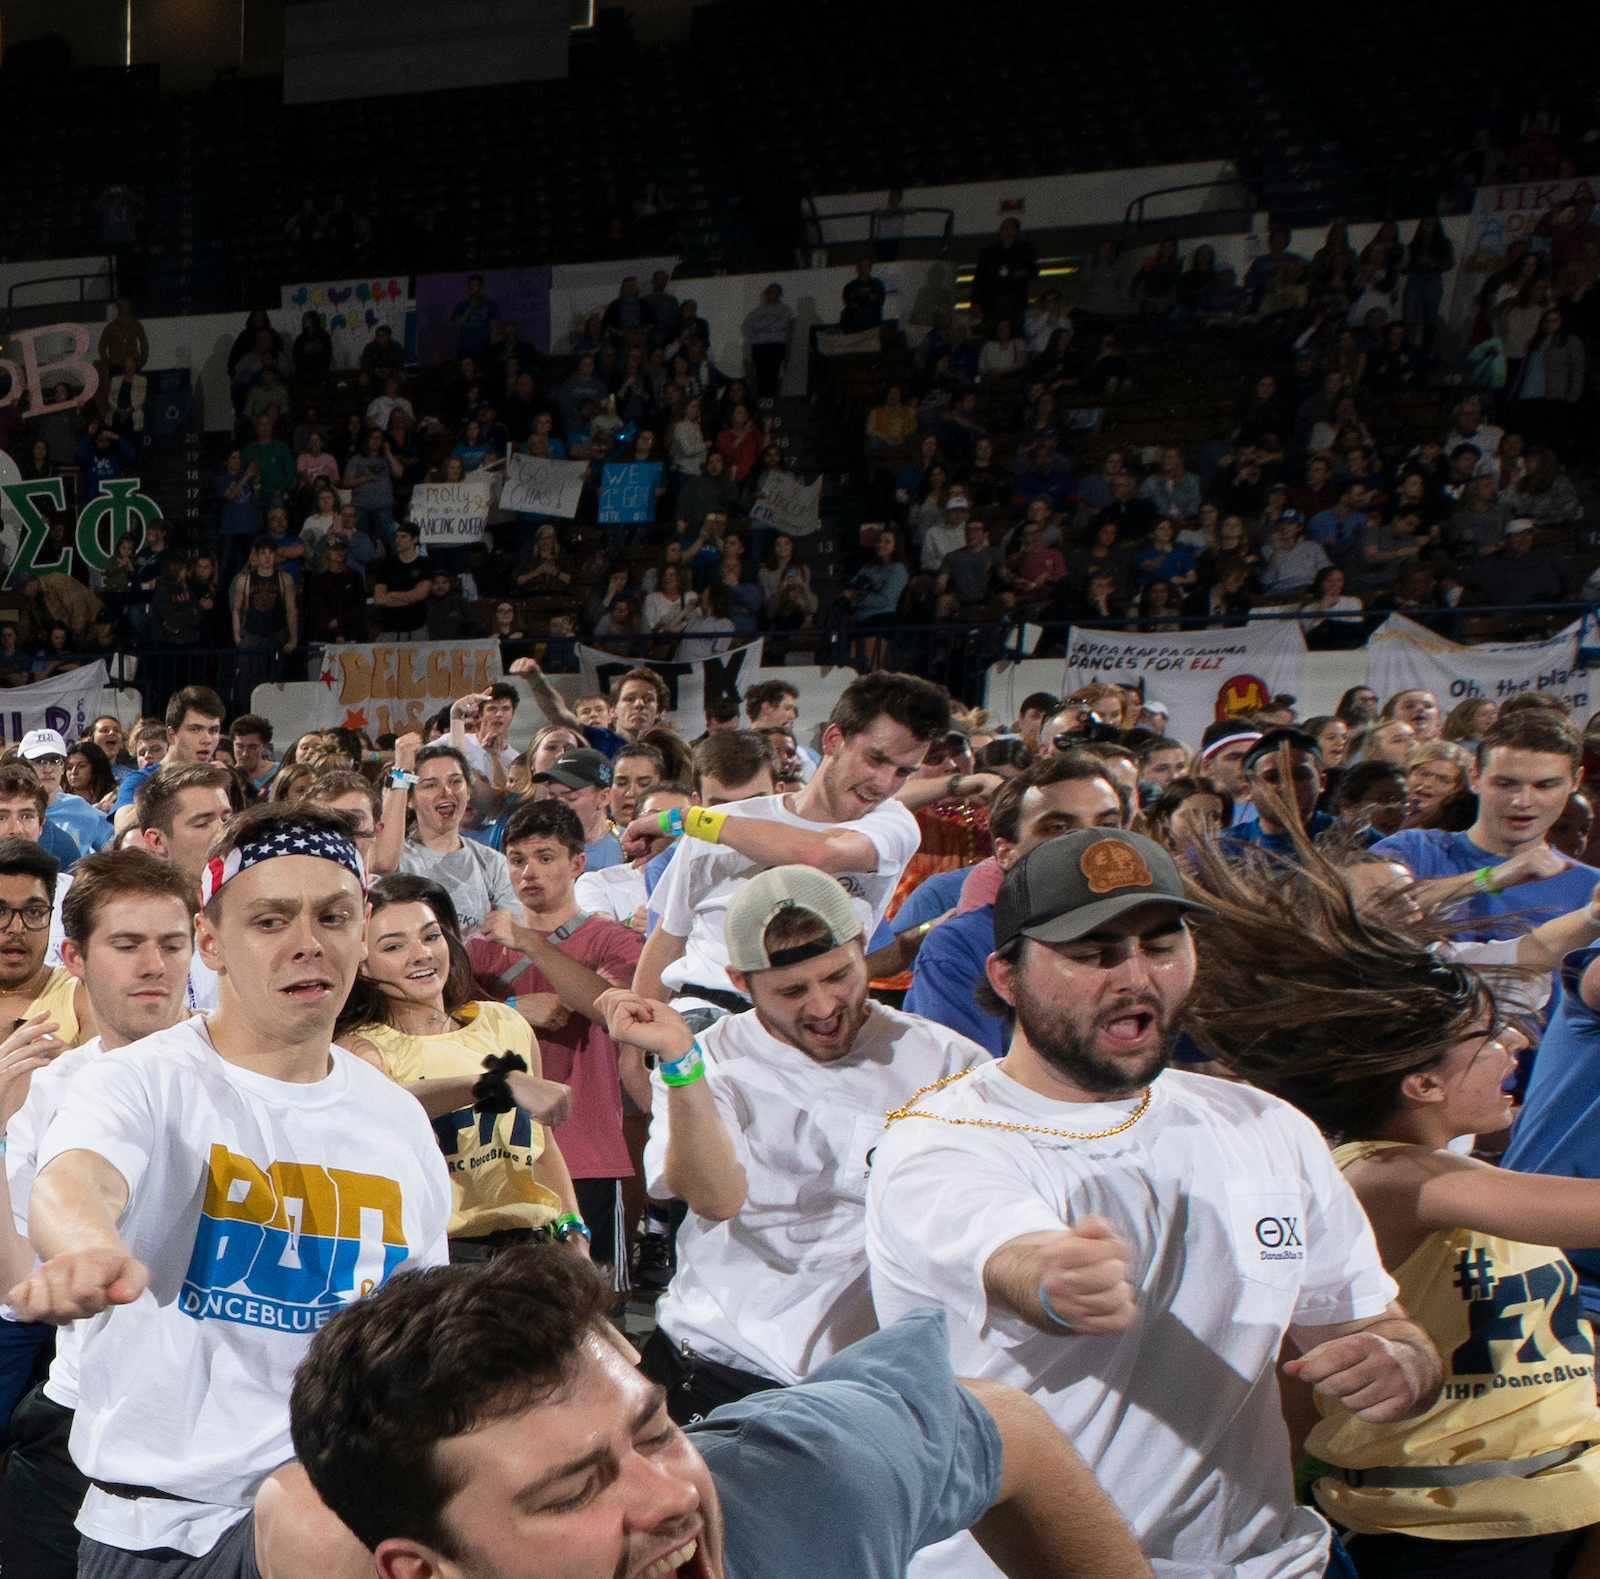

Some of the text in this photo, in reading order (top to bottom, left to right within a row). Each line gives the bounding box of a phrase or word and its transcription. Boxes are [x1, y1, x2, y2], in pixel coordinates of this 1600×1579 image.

[1069, 654, 1226, 671] DANCES FOR ELI
[1496, 677, 1531, 697] the
